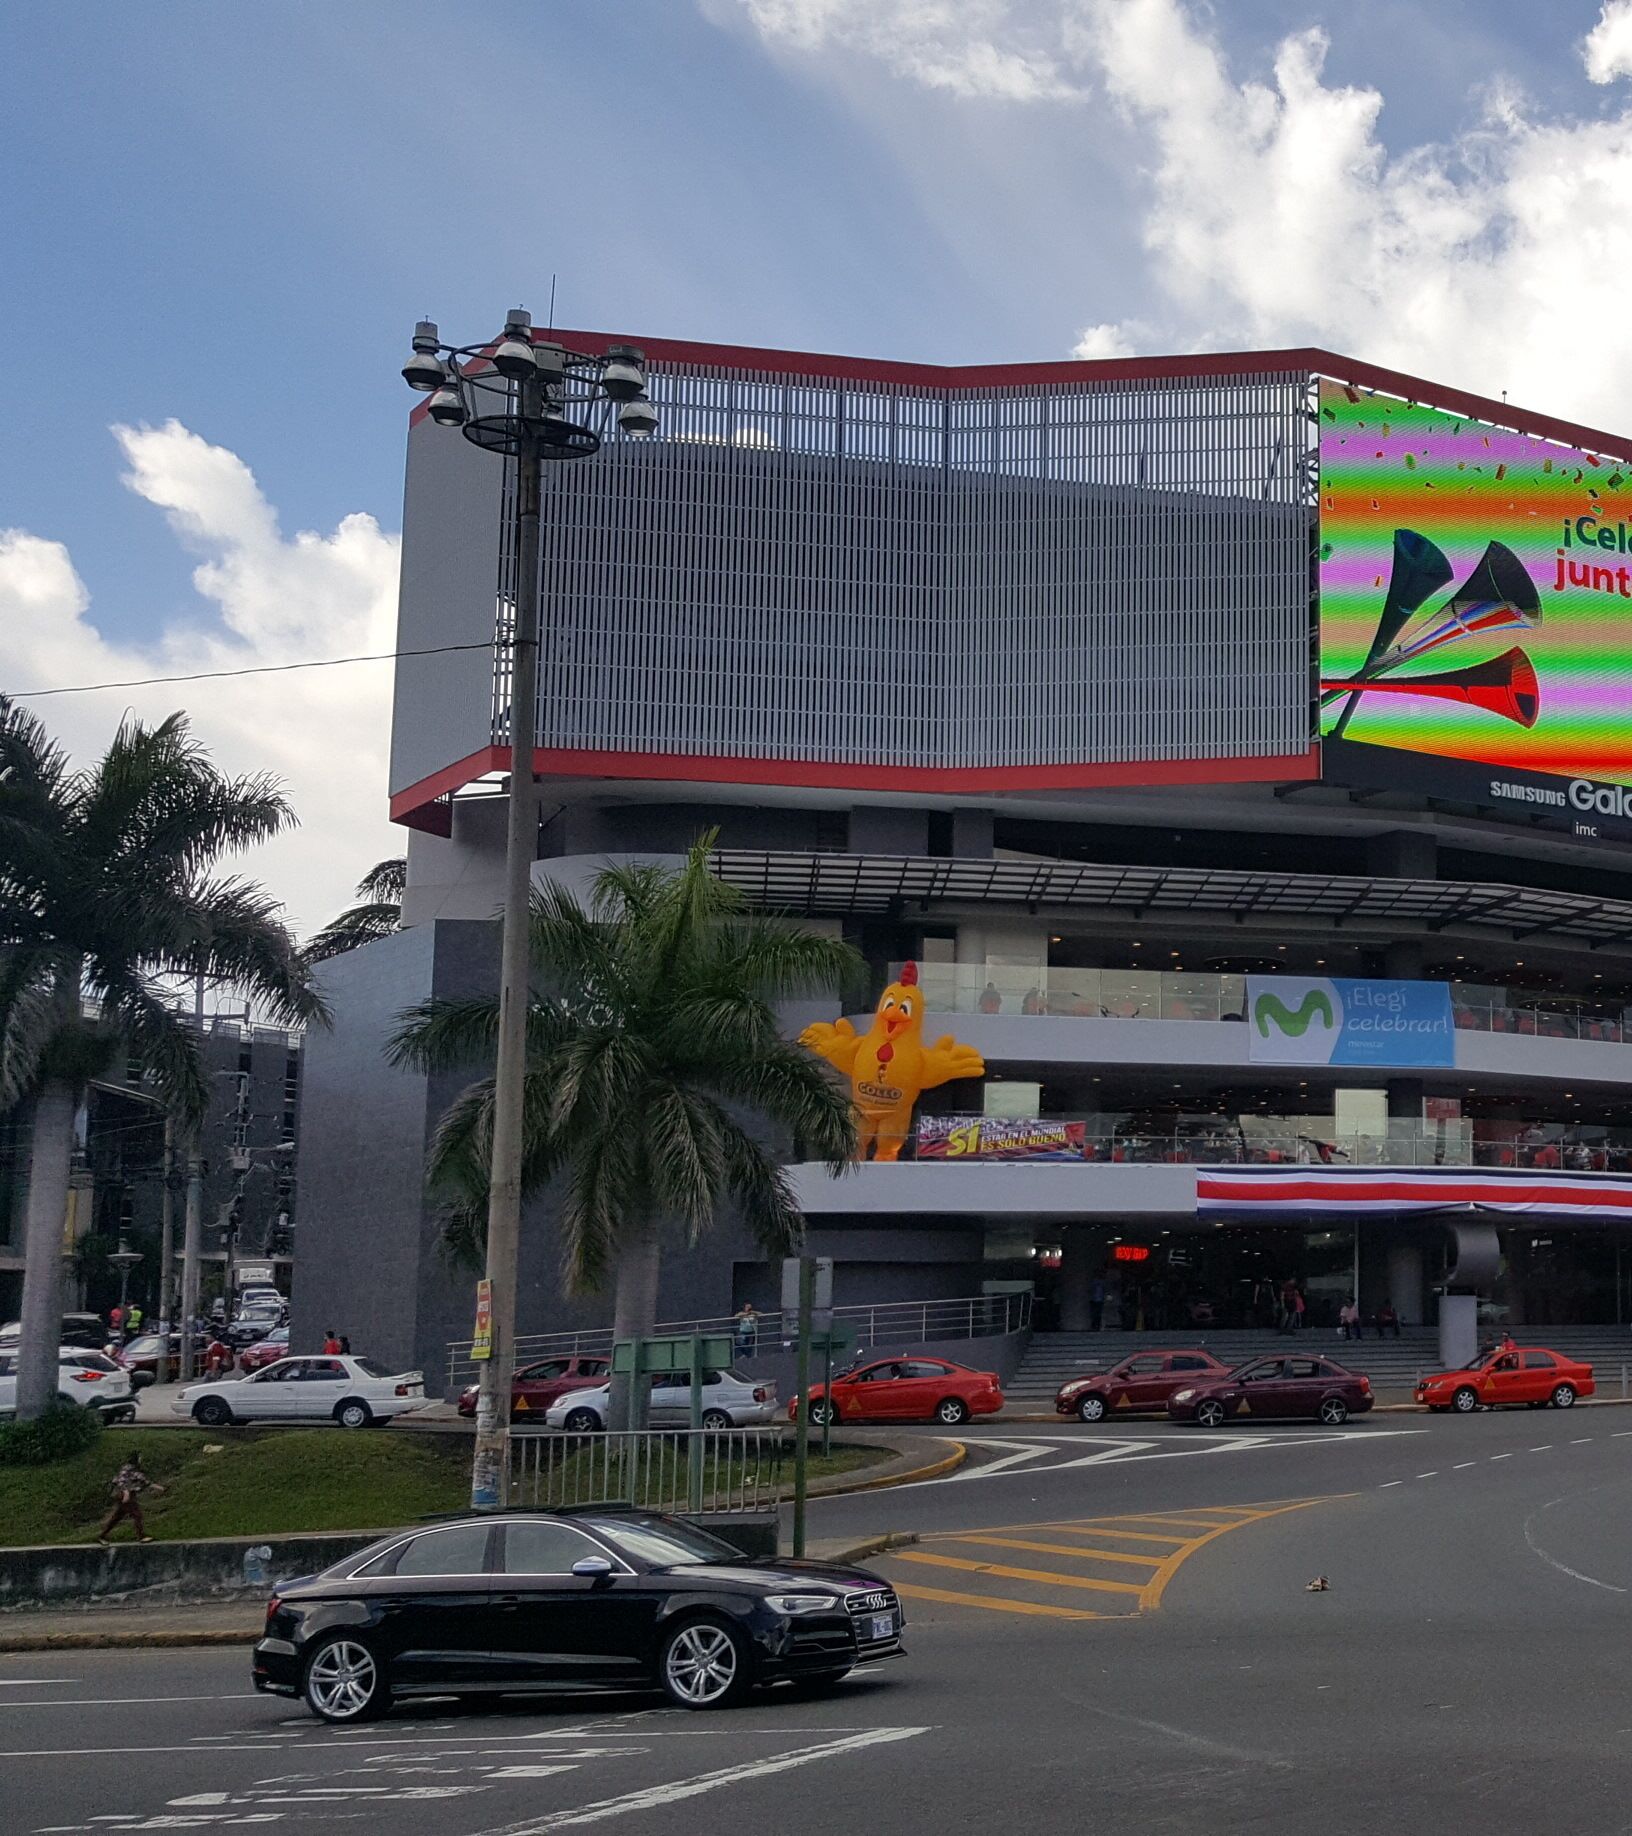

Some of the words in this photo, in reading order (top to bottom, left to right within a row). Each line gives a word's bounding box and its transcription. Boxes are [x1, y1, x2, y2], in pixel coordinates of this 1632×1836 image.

[1490, 781, 1566, 807] SAMSUNG
[1575, 822, 1598, 837] imc
[1347, 1014, 1449, 1034] celebrar!
[981, 1133, 1006, 1143] ESTAR
[1031, 1126, 1066, 1137] MUNDIAL
[981, 1140, 995, 1151] ES
[1029, 1133, 1066, 1145] BUENO
